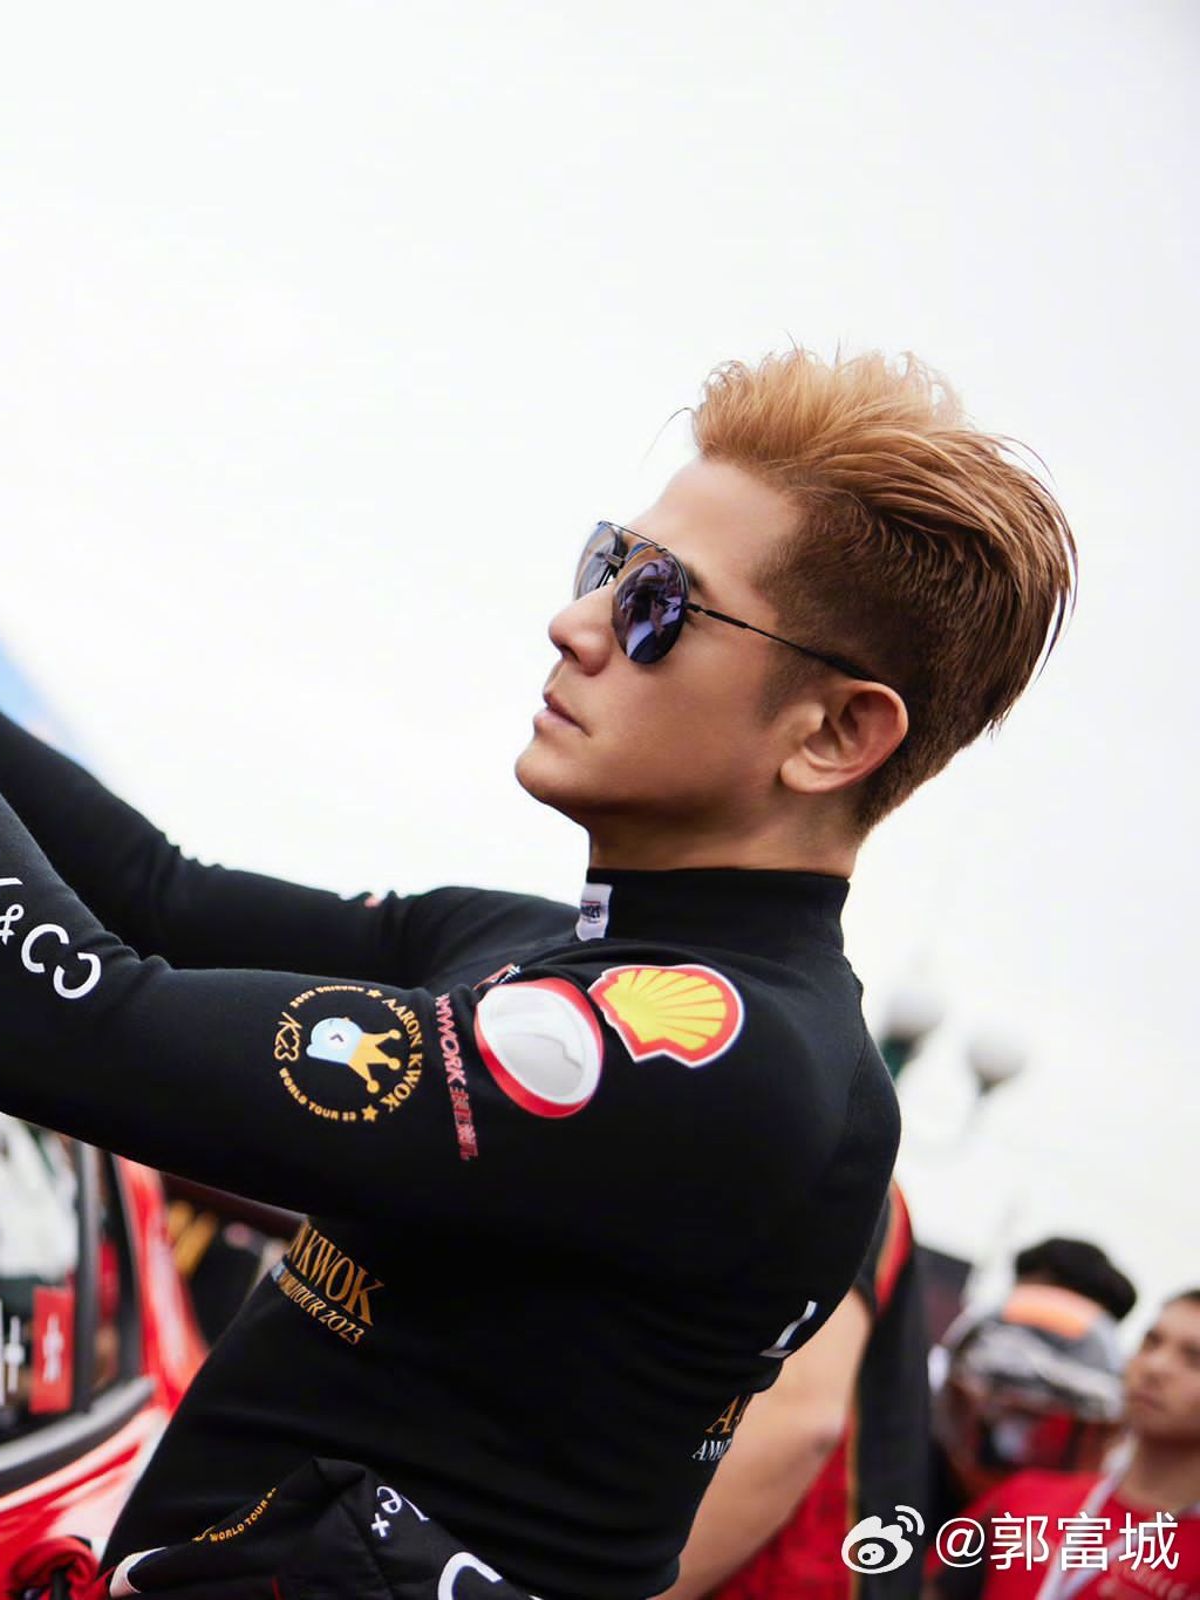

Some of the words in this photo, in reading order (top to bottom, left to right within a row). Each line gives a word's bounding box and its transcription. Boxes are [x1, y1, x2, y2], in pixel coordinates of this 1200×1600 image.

[382, 998, 422, 1048] AARON
[279, 1067, 307, 1105] WORLD
[308, 1100, 339, 1121] TOUR
[380, 1053, 423, 1113] KWOK
[318, 1310, 365, 1344] 2023
[209, 1523, 245, 1542] WORLD
[244, 1499, 268, 1526] TOUR
